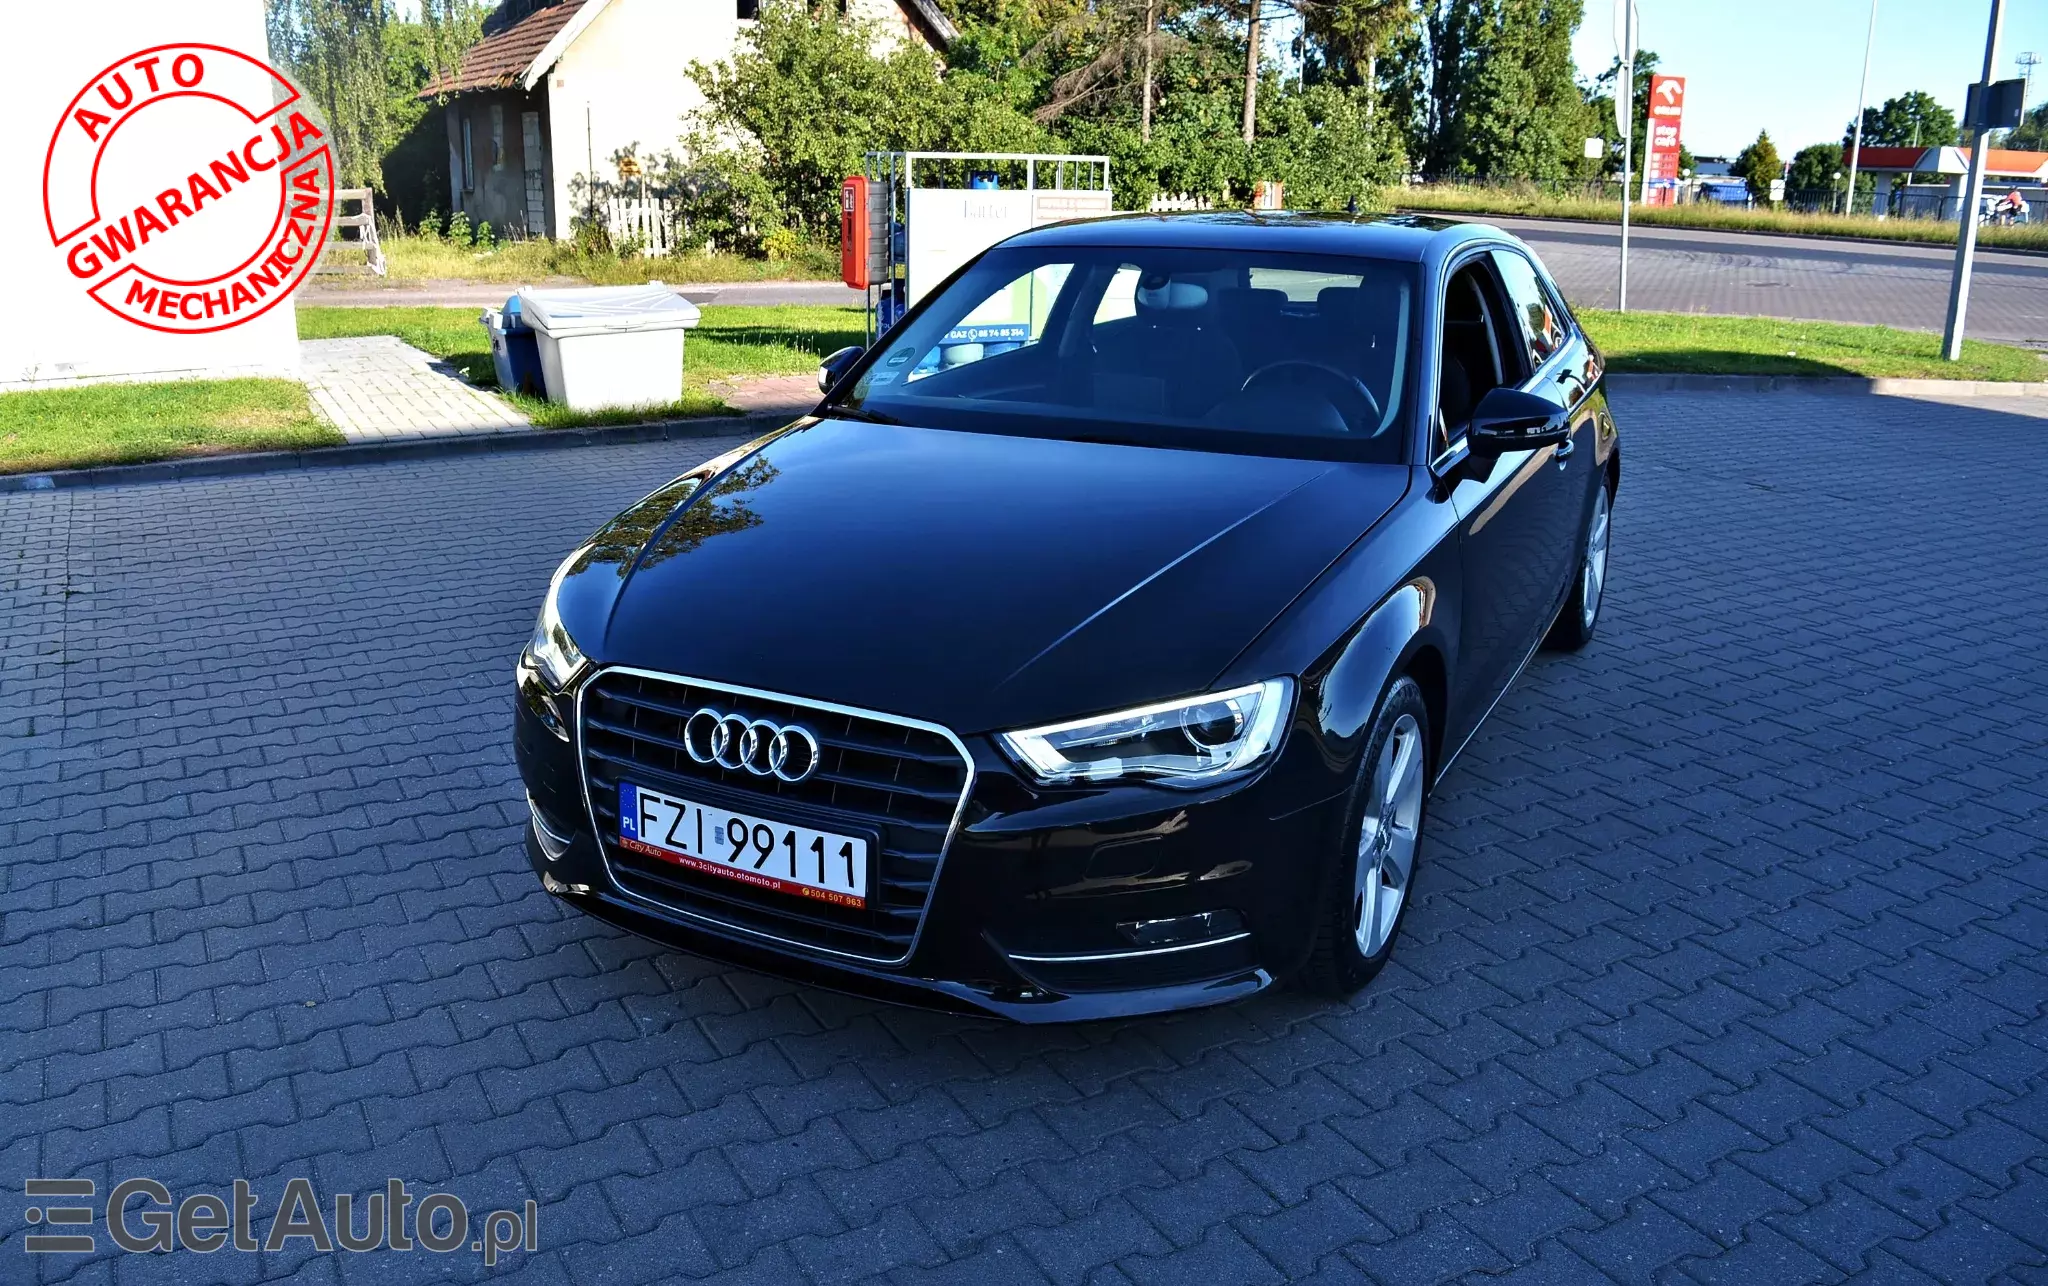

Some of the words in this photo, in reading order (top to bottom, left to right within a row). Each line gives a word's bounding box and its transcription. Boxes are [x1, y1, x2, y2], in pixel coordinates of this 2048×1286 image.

[622, 816, 636, 832] PL
[629, 841, 645, 852] City
[645, 845, 662, 857] Auto
[640, 792, 703, 855] FZI
[727, 817, 855, 889] 99111
[679, 857, 781, 890] www.3cityauto.otomoto.pl
[810, 889, 826, 900] 504
[828, 892, 843, 903] 507
[846, 897, 862, 907] 963
